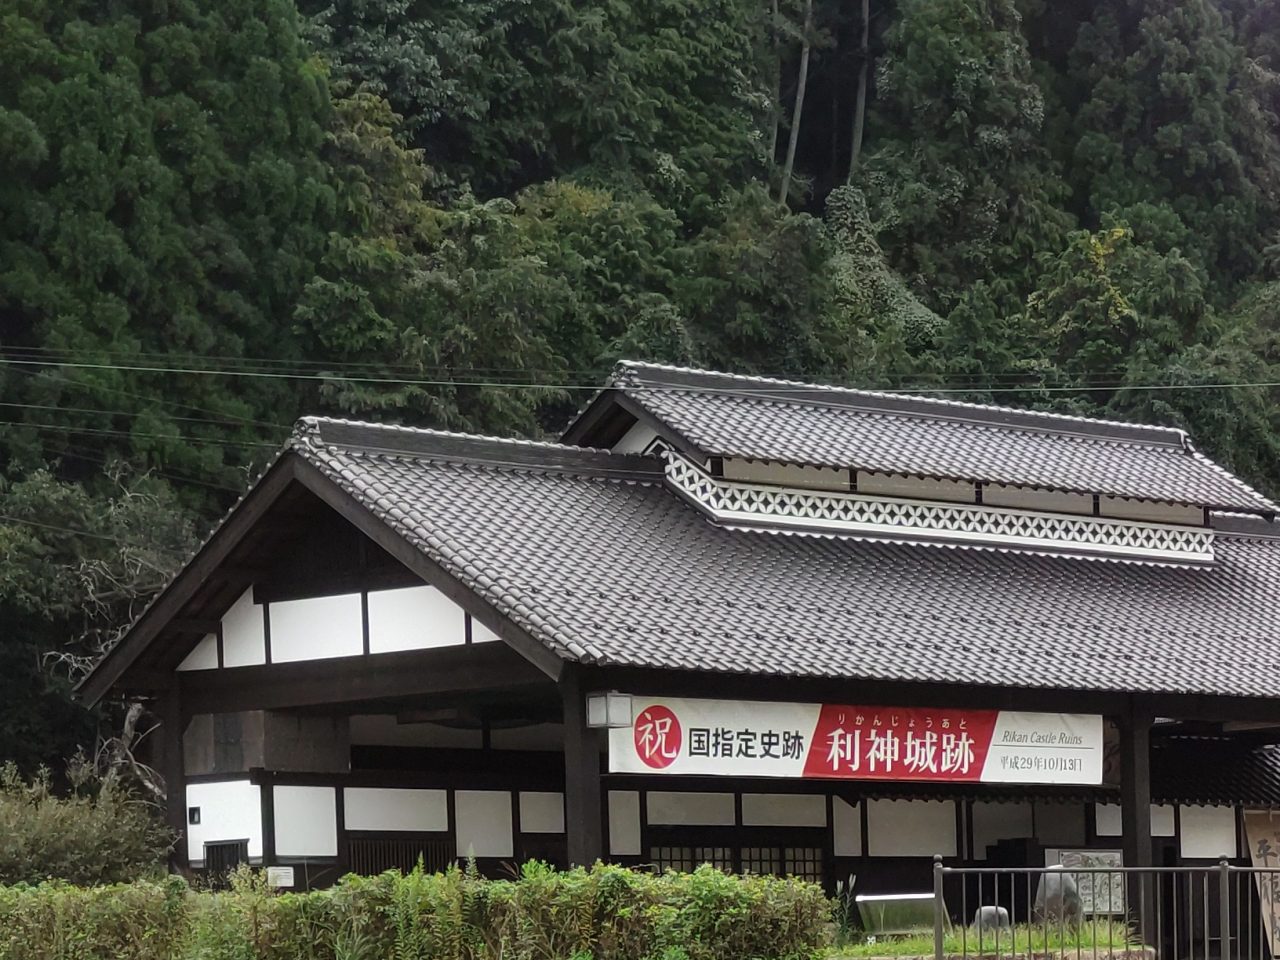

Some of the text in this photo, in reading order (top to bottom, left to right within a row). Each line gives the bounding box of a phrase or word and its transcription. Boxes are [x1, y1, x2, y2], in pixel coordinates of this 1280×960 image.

[837, 713, 968, 730] りかんじょうあと
[637, 712, 677, 759] 祝
[688, 727, 804, 760] 国指定史跡
[1002, 730, 1083, 745] Rikan Castle Ruins
[826, 727, 975, 774] 利神城跡
[1000, 755, 1083, 772] 平成29年10月13日
